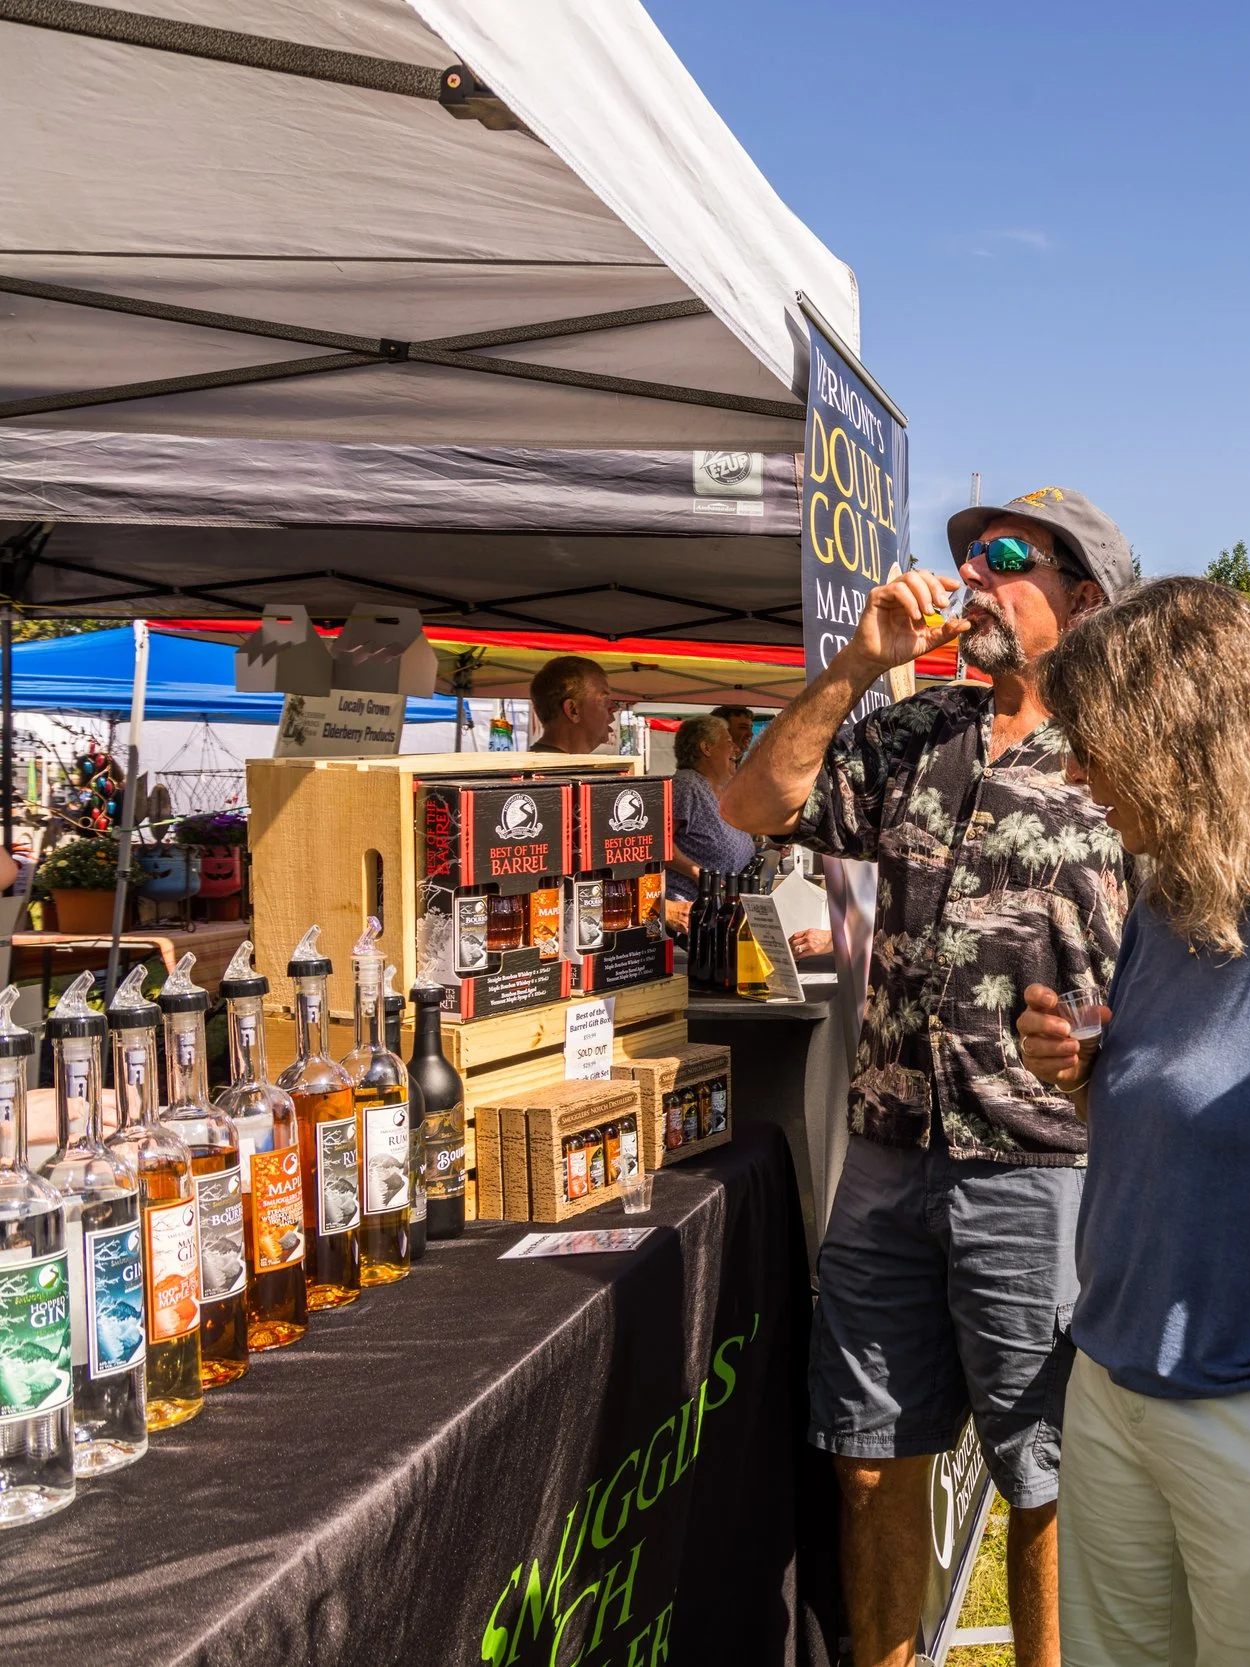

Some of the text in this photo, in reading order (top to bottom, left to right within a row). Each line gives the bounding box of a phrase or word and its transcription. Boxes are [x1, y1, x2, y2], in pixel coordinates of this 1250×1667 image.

[815, 347, 885, 454] VERMONT'S
[810, 408, 897, 535] DOUBLE
[810, 491, 881, 585] GOLD
[816, 577, 868, 627] MAP
[338, 696, 365, 716] Locally
[366, 699, 391, 716] Grown
[322, 722, 364, 743] Elderberry
[364, 726, 396, 743] Products
[426, 800, 436, 876] BEST OF THE
[436, 802, 450, 876] BARREL
[604, 834, 653, 849] BEST OF THE
[490, 843, 549, 859] BEST OF THE
[605, 845, 653, 865] BARREL
[491, 855, 548, 876] BARREL
[569, 1017, 611, 1033] Barrel Gift Box
[576, 1011, 588, 1020] Best
[589, 1009, 596, 1017] of
[577, 1044, 608, 1059] SOLD OUT
[589, 1072, 601, 1081] Gift
[600, 1069, 610, 1078] Set
[343, 1149, 357, 1166] RY
[268, 1175, 302, 1197] MAPL
[30, 1295, 66, 1315] HOPPED
[30, 1303, 67, 1329] GIN
[952, 1416, 976, 1493] NOTCH
